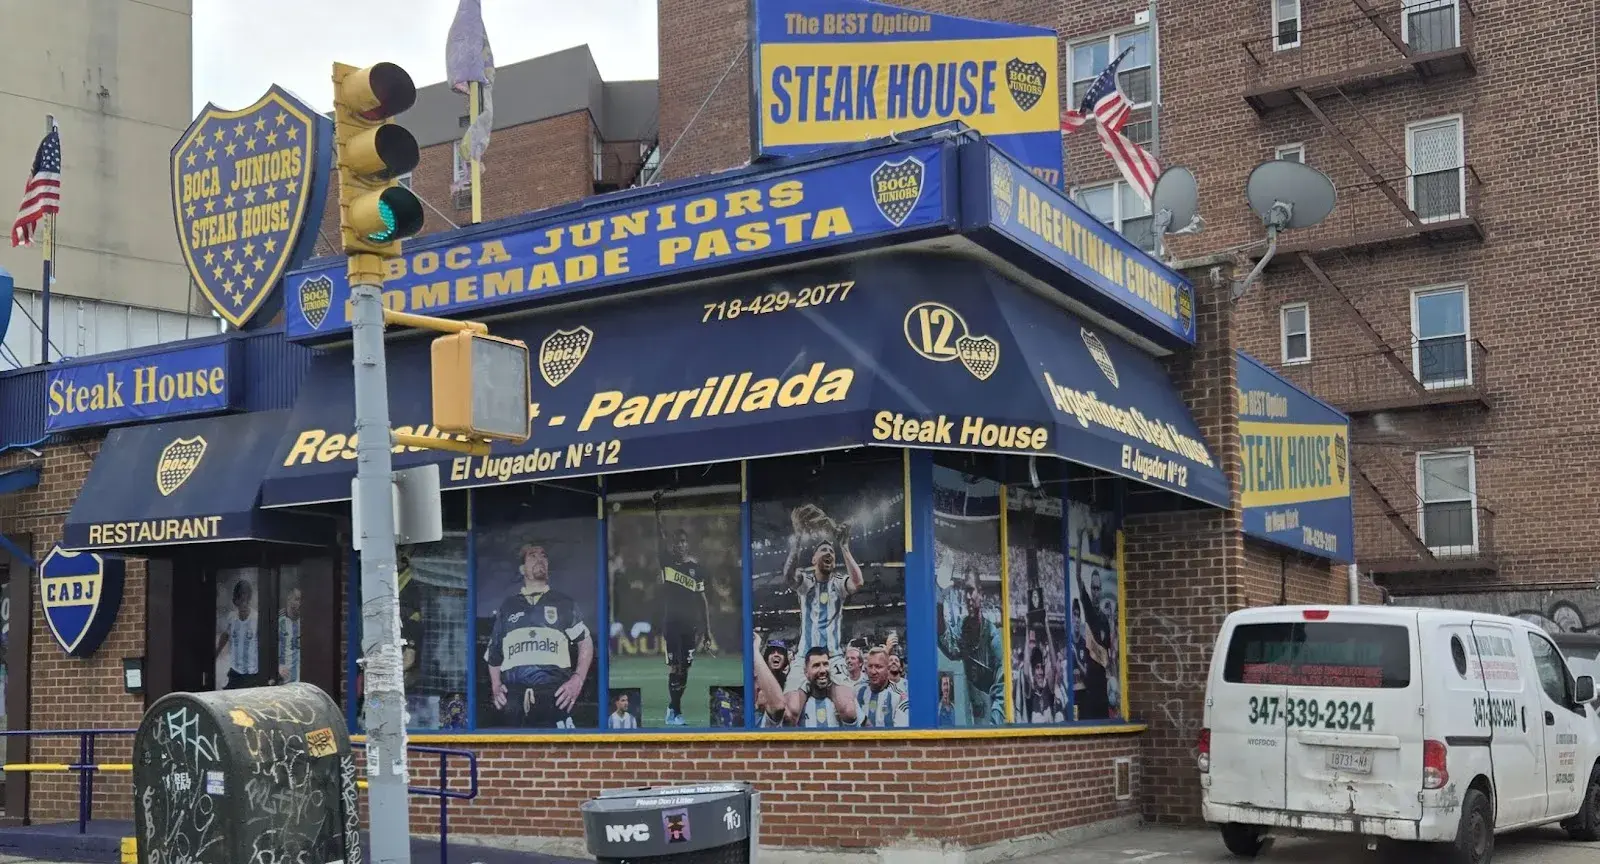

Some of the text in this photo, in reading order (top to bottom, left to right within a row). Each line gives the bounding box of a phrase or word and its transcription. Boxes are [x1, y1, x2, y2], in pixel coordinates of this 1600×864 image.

[785, 12, 932, 36] The BEST Option
[770, 60, 997, 124] STEAK HOUSE
[1009, 70, 1042, 87] BOCA
[1009, 80, 1043, 96] JUNIORS
[183, 146, 301, 203] BOCA JUNIORS
[877, 175, 917, 193] BOCA
[876, 186, 918, 203] JUNIORS
[192, 199, 290, 250] STEAK HOUSE
[381, 180, 804, 281] BOCA JUNIORS
[345, 206, 853, 322] OMEMADE PASTA
[1018, 184, 1178, 319] ARGENTINIAN CUISINE
[303, 289, 329, 302] BOCA
[303, 299, 329, 311] JUNIORS
[701, 281, 856, 323] 718-429-2077
[917, 307, 957, 355] 12
[543, 346, 583, 363] BOCA
[48, 365, 225, 416] Steak House
[577, 361, 856, 432] Parrillada
[872, 410, 1048, 451] Steak House
[1129, 406, 1179, 453] Steak
[1165, 423, 1214, 468] House
[161, 457, 195, 472] BOCA
[450, 456, 472, 482] El
[475, 449, 561, 483] Jugador
[1122, 444, 1132, 469] El
[1132, 449, 1167, 480] Jugador
[1287, 434, 1332, 490] HOUSE
[89, 516, 222, 545] RESTAURANT
[47, 581, 95, 602] CABJ
[508, 638, 559, 660] parmalat
[1248, 696, 1376, 732] 347-339-2324
[605, 823, 650, 843] NYC
